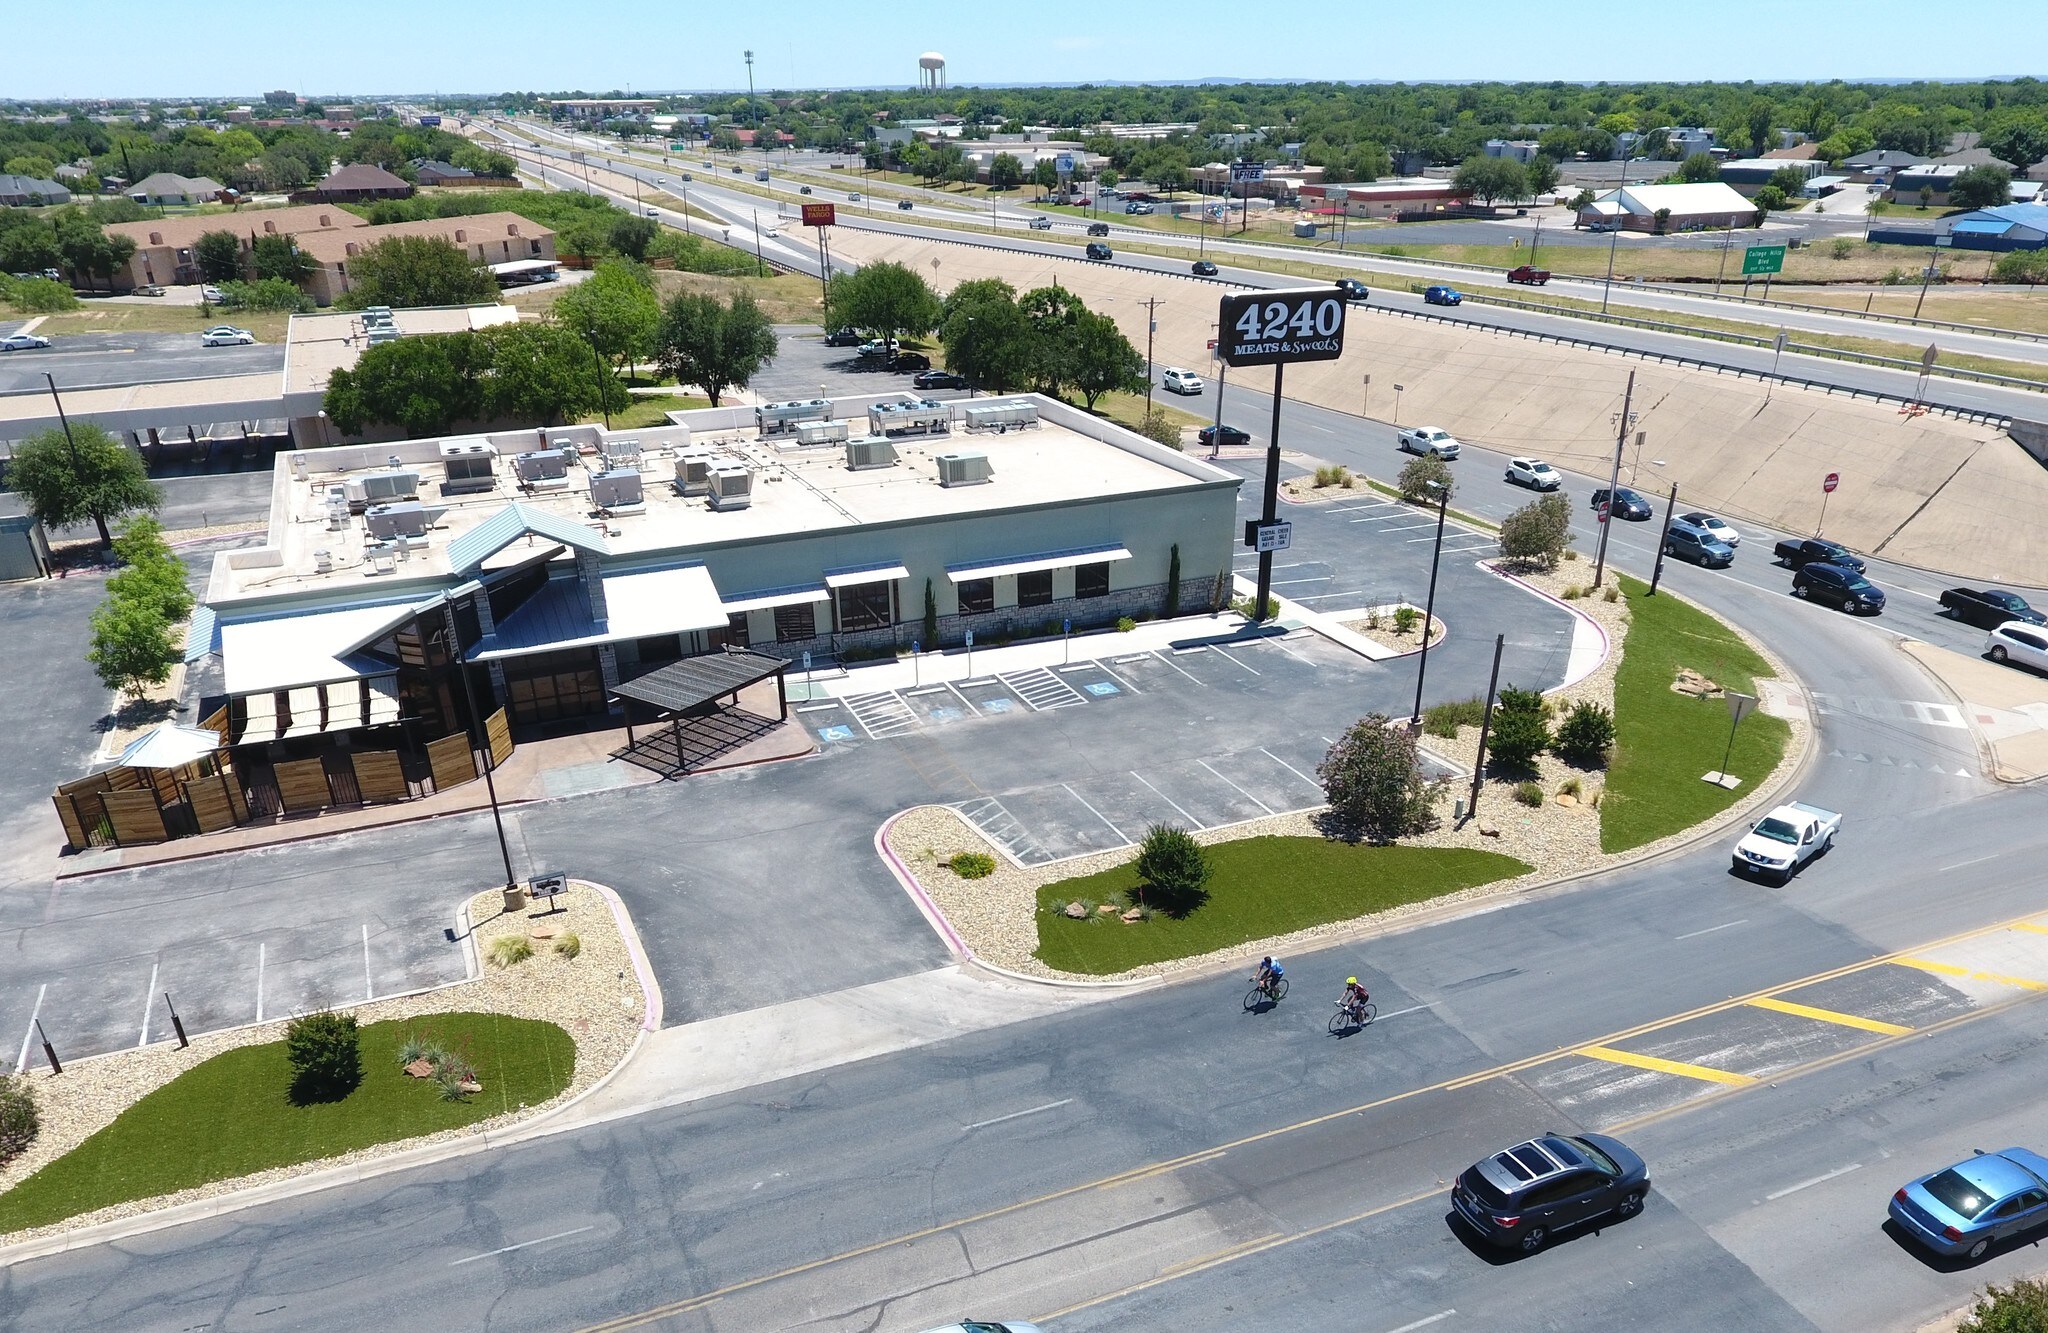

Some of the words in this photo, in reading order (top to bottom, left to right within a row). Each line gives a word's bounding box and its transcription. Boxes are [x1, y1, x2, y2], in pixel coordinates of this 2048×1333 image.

[1236, 299, 1342, 340] 4240
[1234, 342, 1279, 355] MEATS
[1281, 341, 1291, 352] &
[1291, 338, 1339, 354] Sweets
